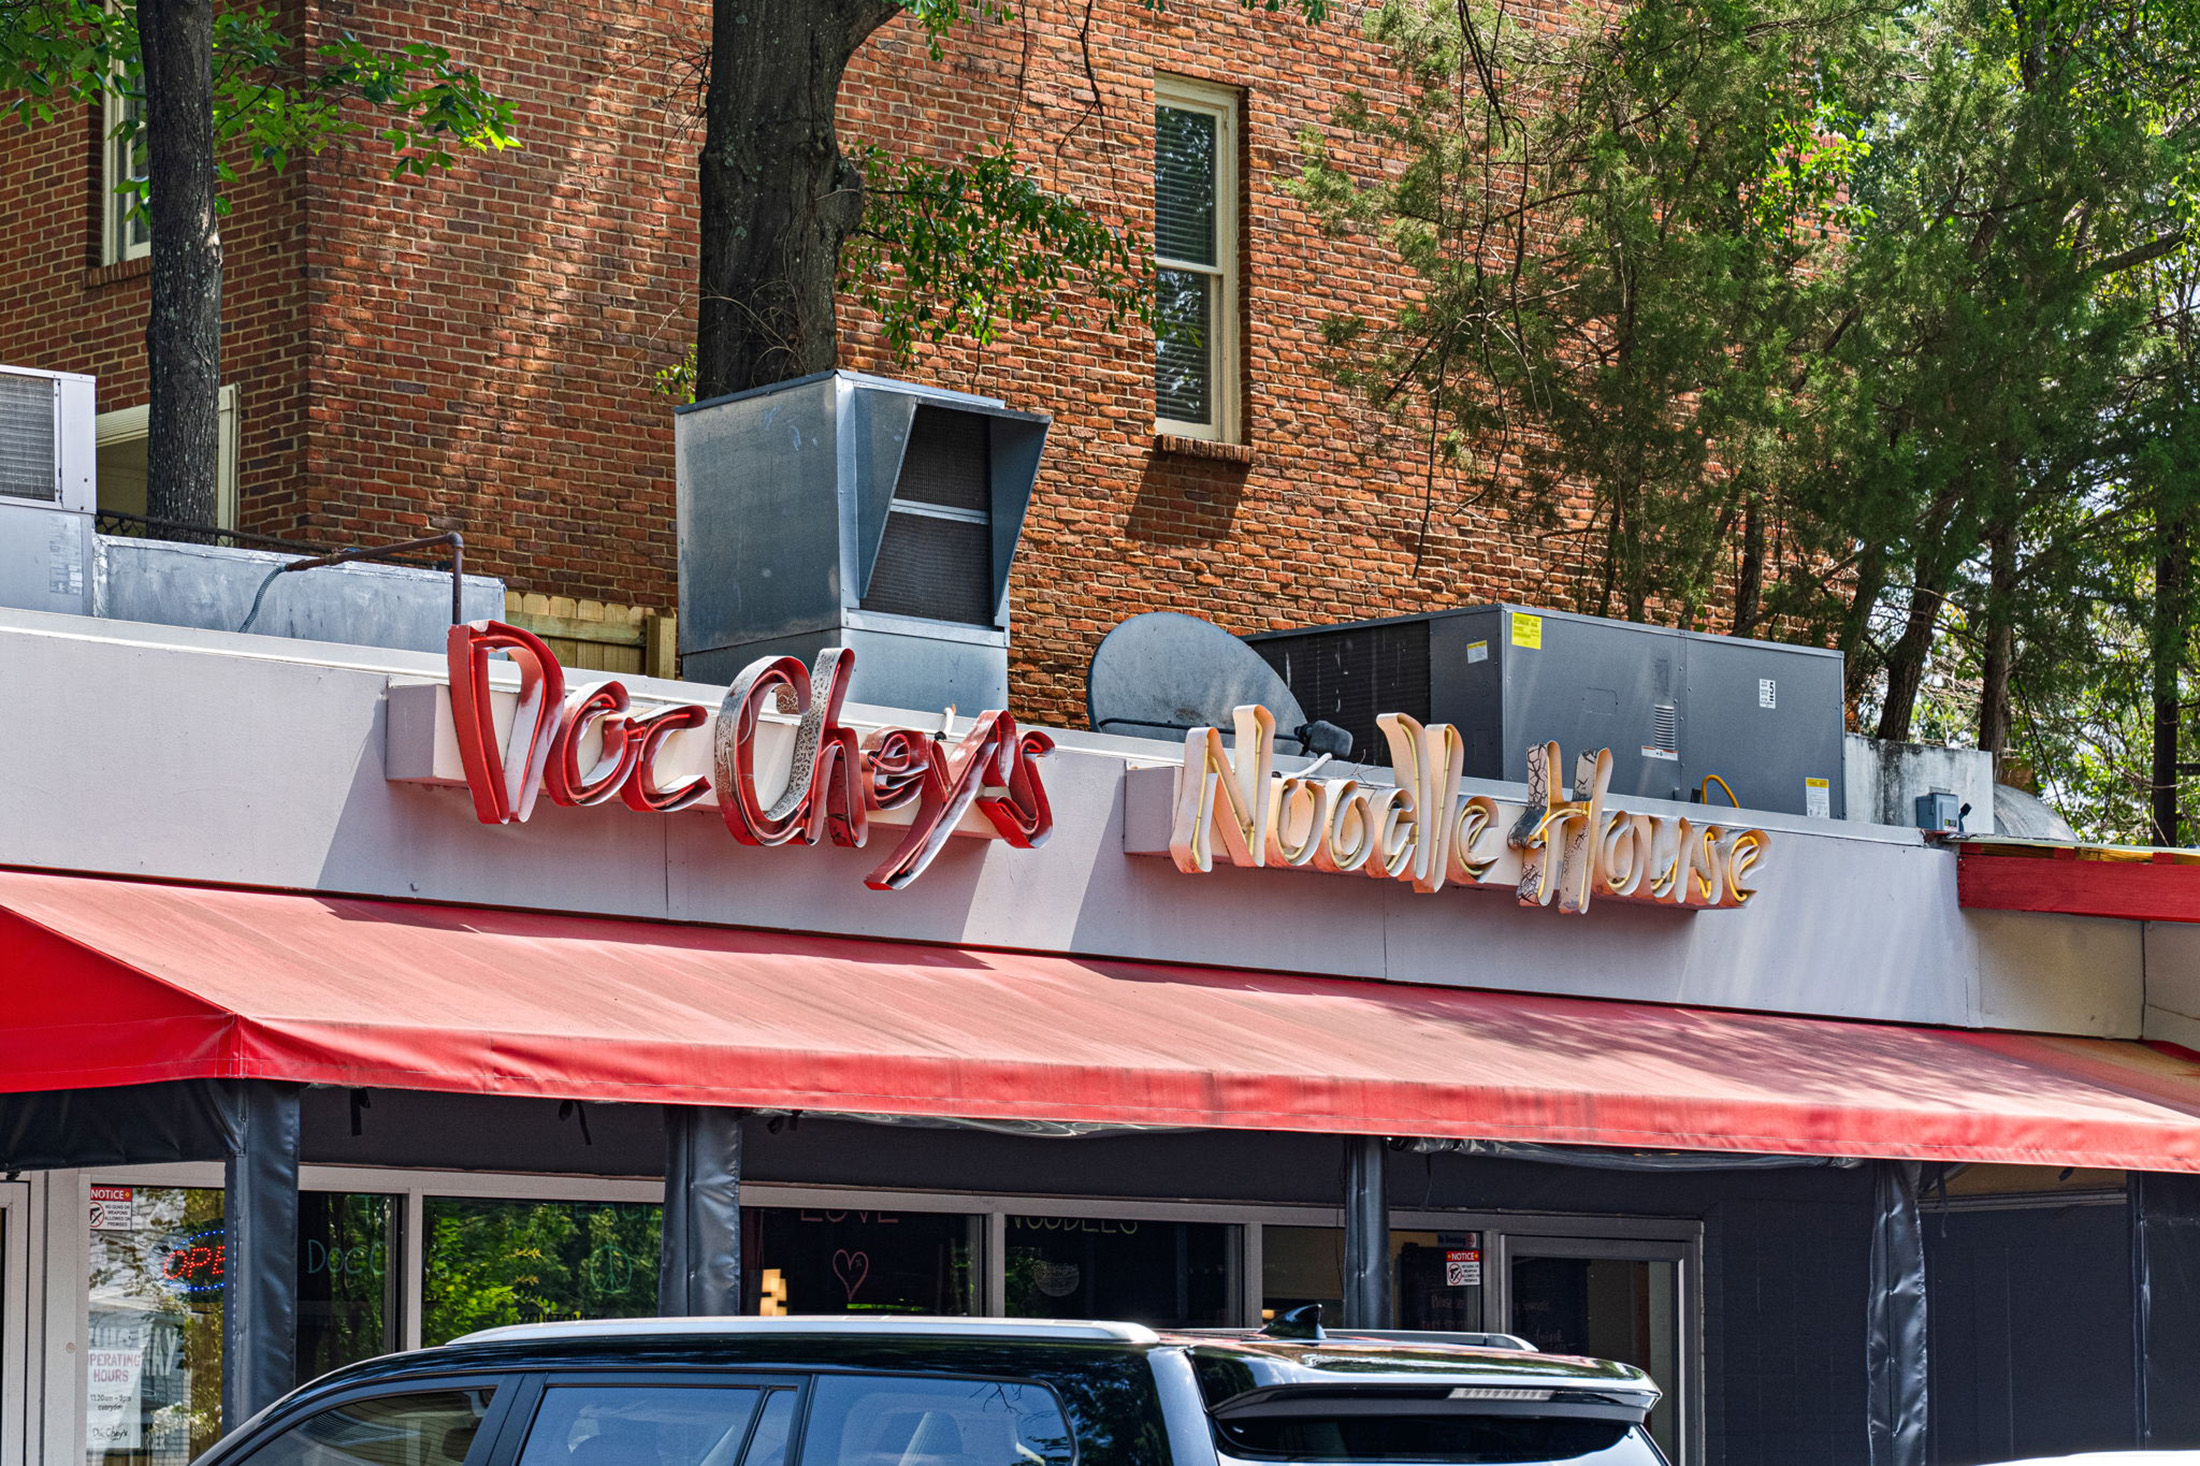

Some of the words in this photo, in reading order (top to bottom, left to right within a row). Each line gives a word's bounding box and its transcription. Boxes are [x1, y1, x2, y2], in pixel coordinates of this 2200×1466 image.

[447, 620, 711, 825] Doc
[1169, 704, 1500, 894] Noodle
[1507, 740, 1772, 915] House
[90, 1188, 125, 1200] NOTICE
[163, 1244, 226, 1280] OPE
[1451, 1252, 1475, 1261] NOTICE
[89, 1353, 141, 1367] PERATING
[94, 1369, 129, 1383] HOURS
